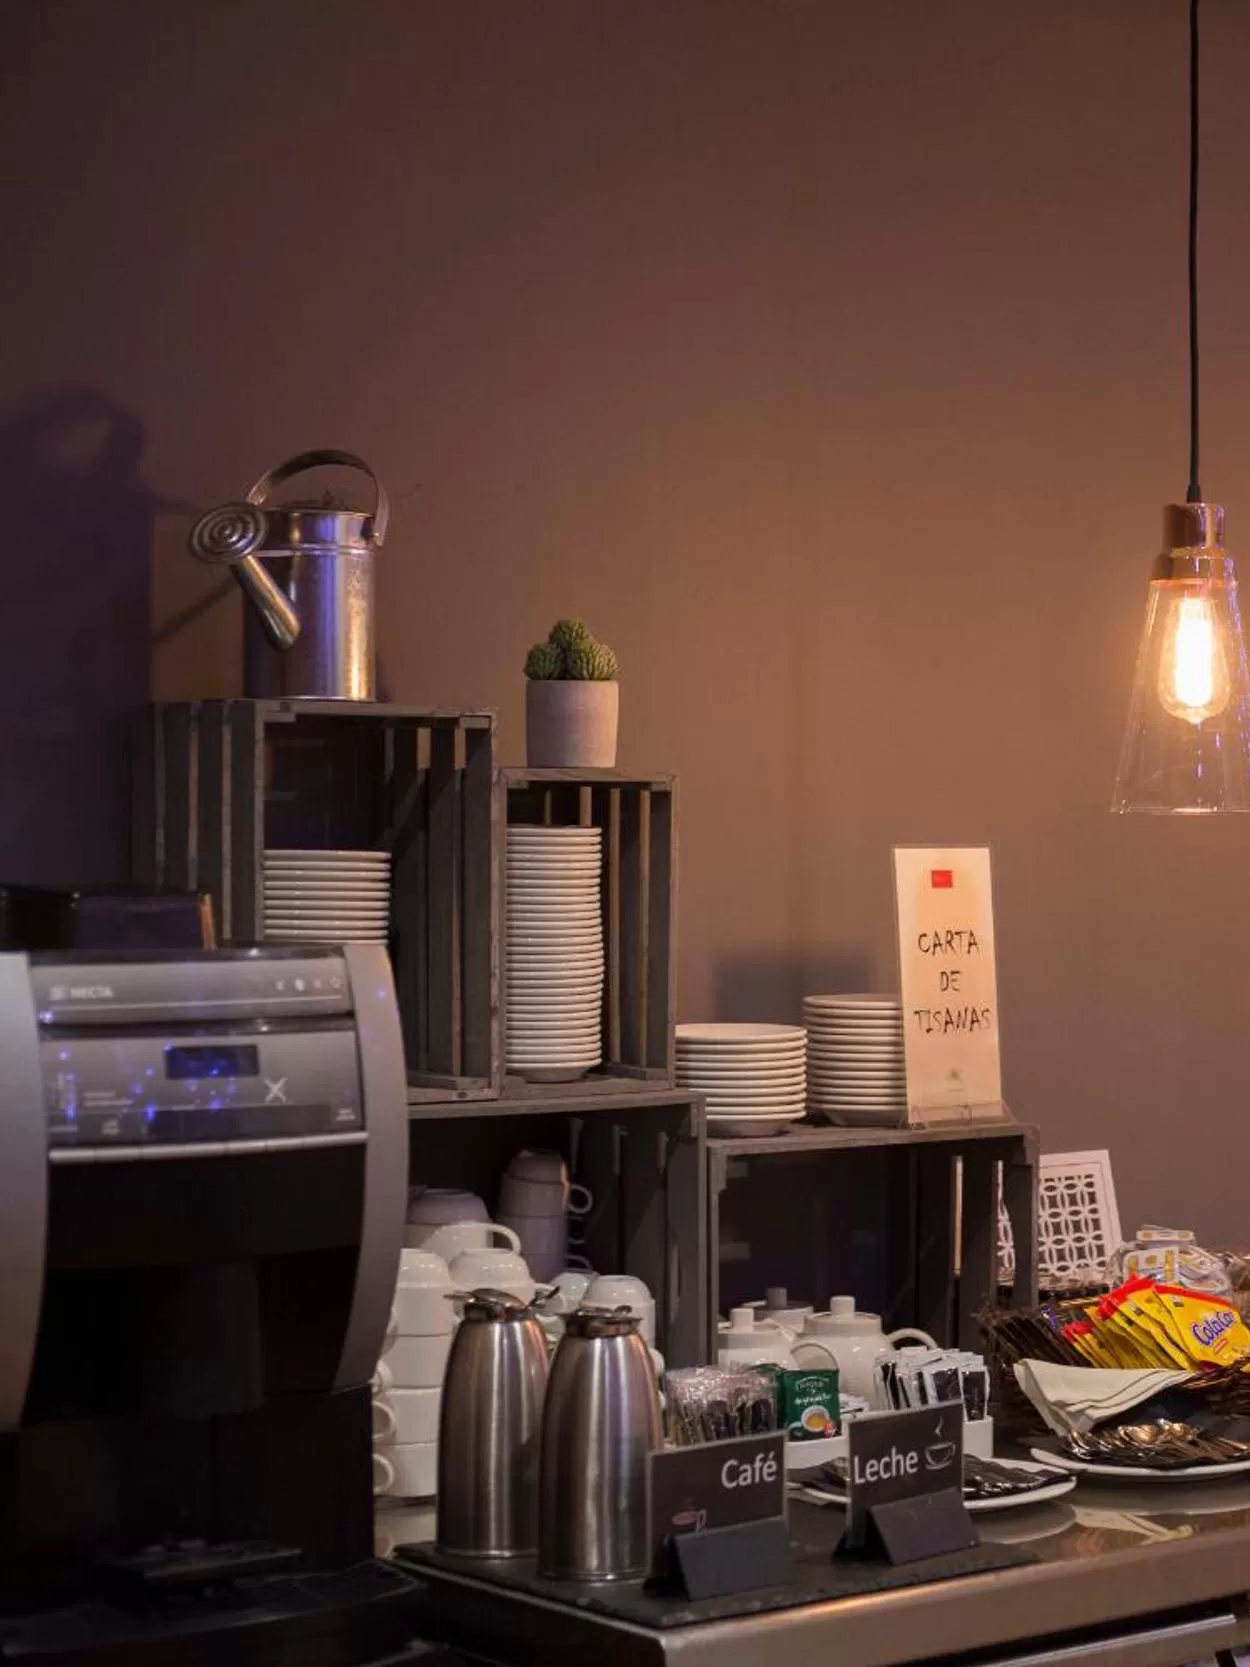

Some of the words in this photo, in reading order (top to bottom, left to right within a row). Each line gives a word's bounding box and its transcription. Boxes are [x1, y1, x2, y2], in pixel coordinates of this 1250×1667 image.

[918, 930, 980, 956] CARTA
[940, 971, 961, 993] DE
[913, 1007, 991, 1033] TISANAS
[721, 1452, 778, 1489] Café
[854, 1446, 919, 1485] Leche
